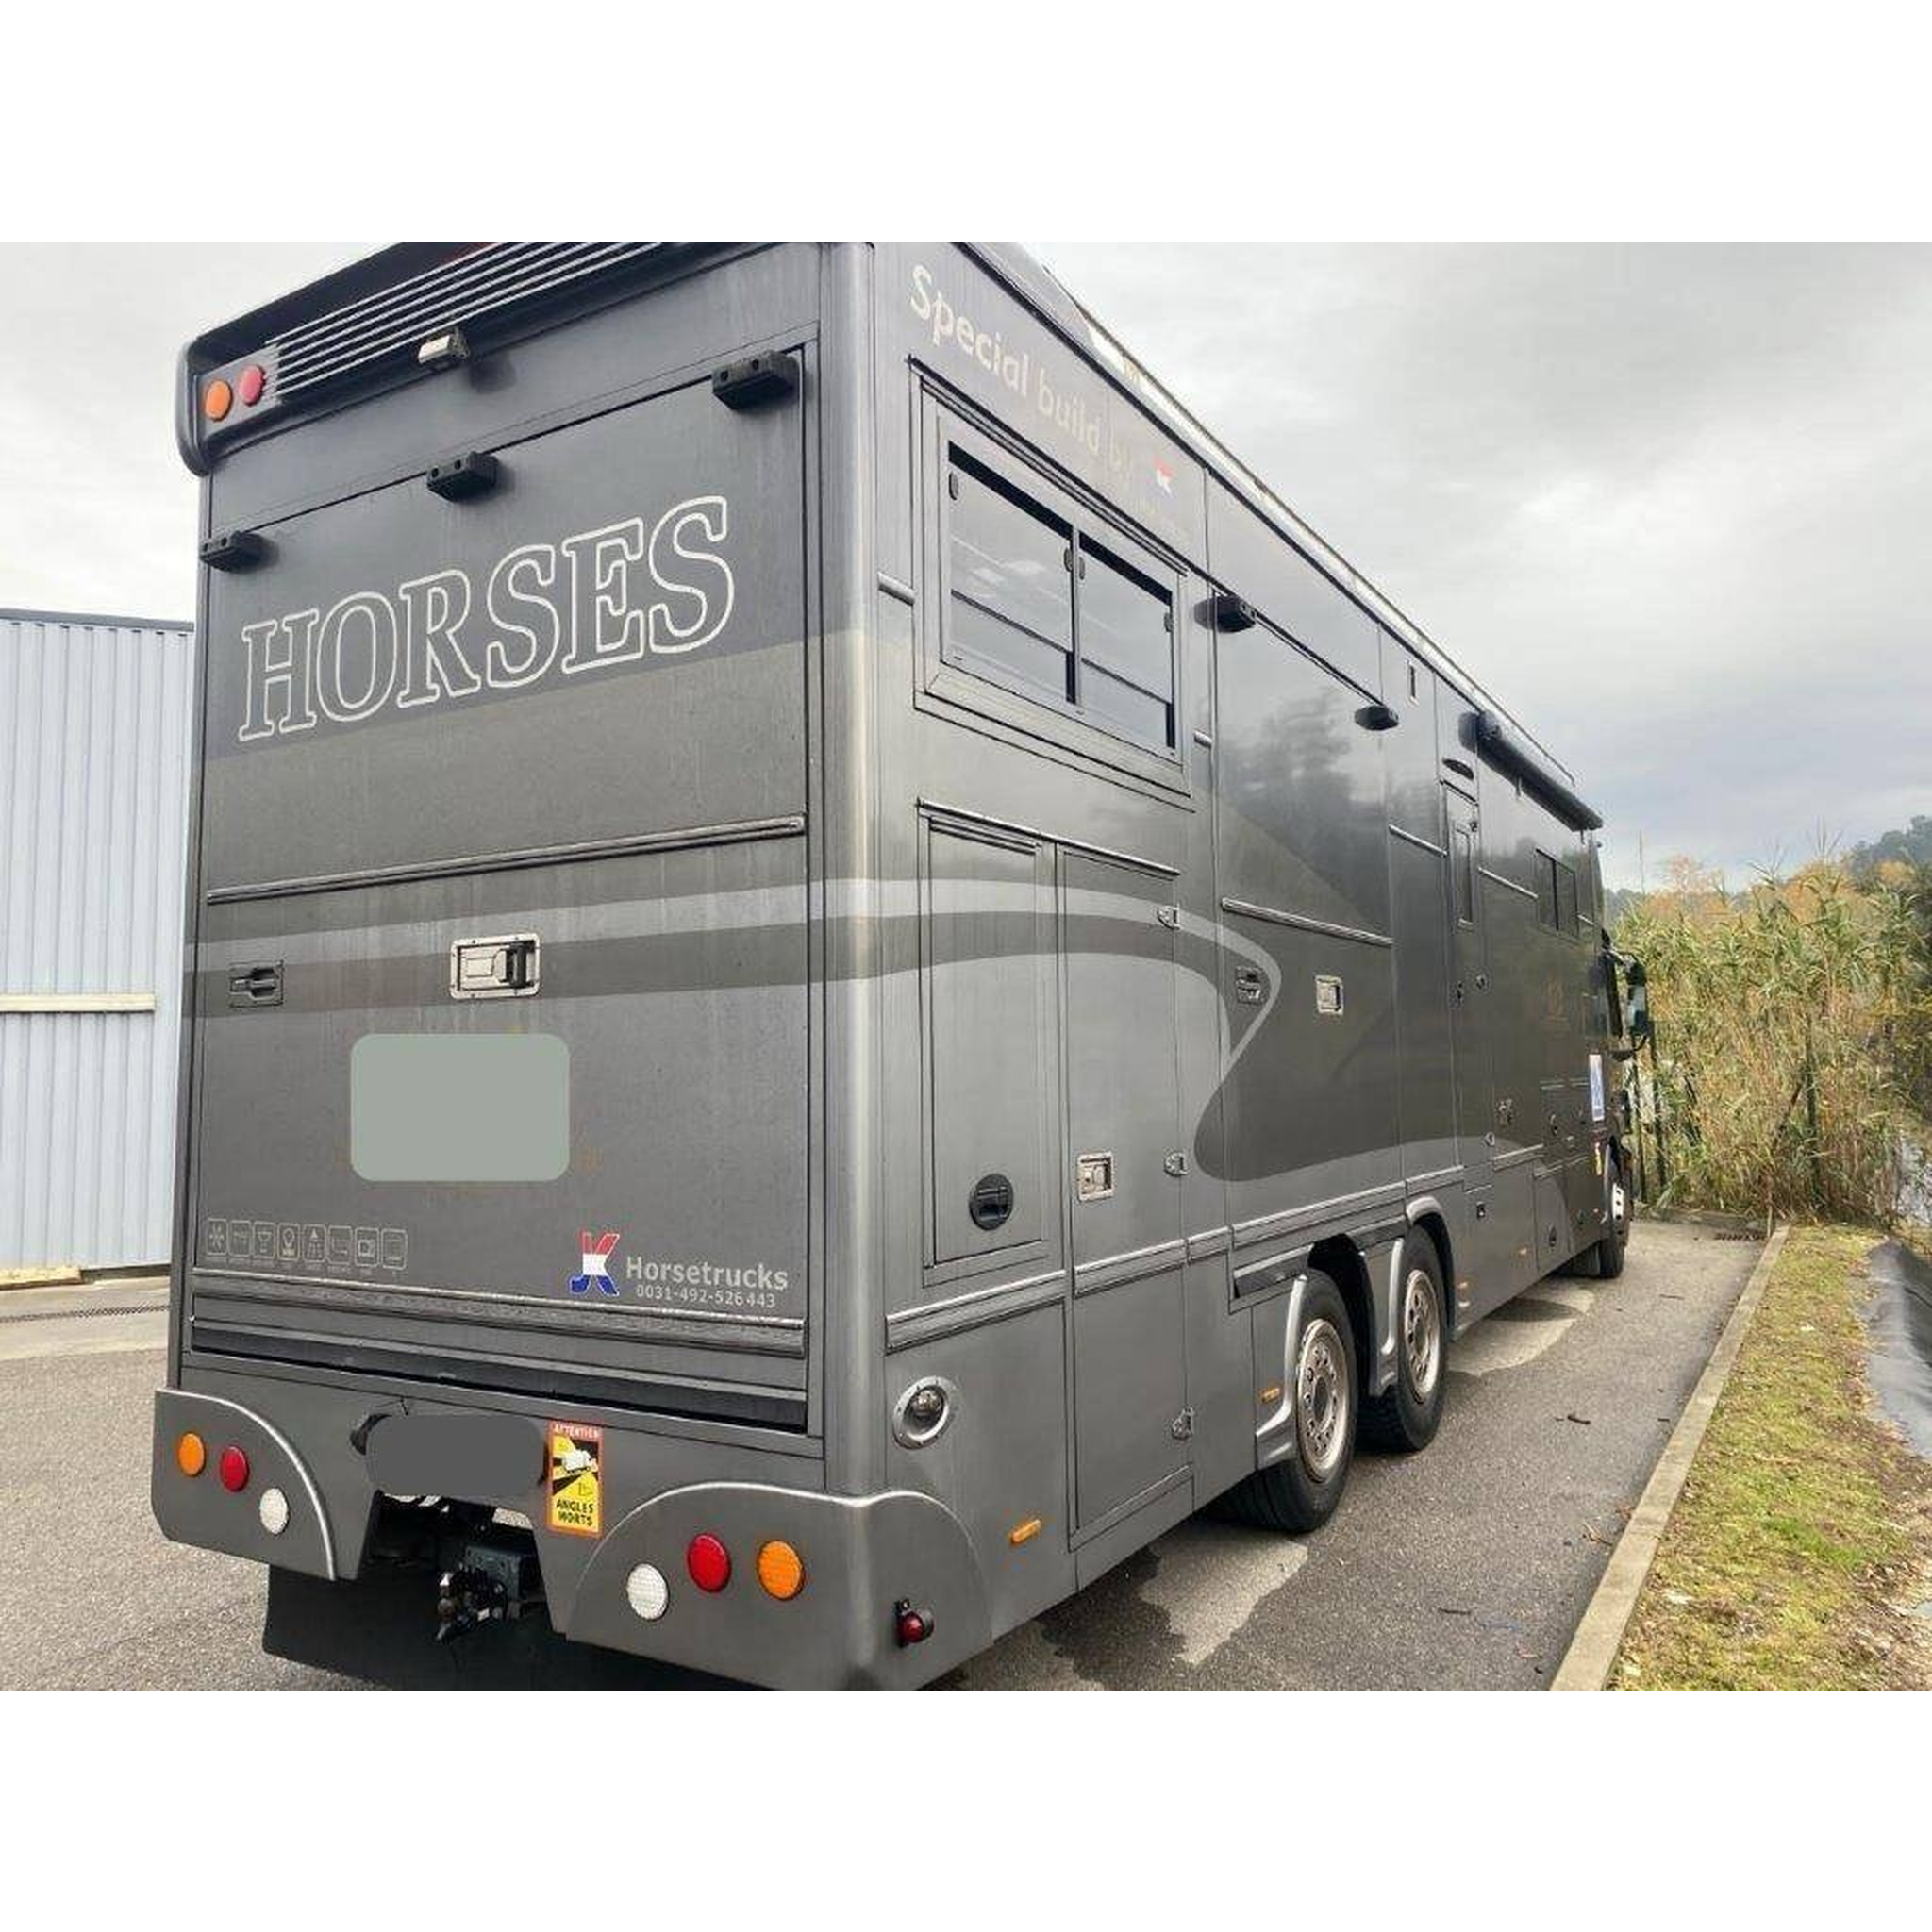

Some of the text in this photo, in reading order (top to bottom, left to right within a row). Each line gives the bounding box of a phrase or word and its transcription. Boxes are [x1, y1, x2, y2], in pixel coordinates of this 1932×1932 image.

[910, 264, 1029, 397] Special
[1038, 369, 1101, 453] build
[238, 495, 735, 741] HORSES
[626, 1256, 789, 1291] Horsetrucks
[557, 1499, 594, 1513] ANGLES
